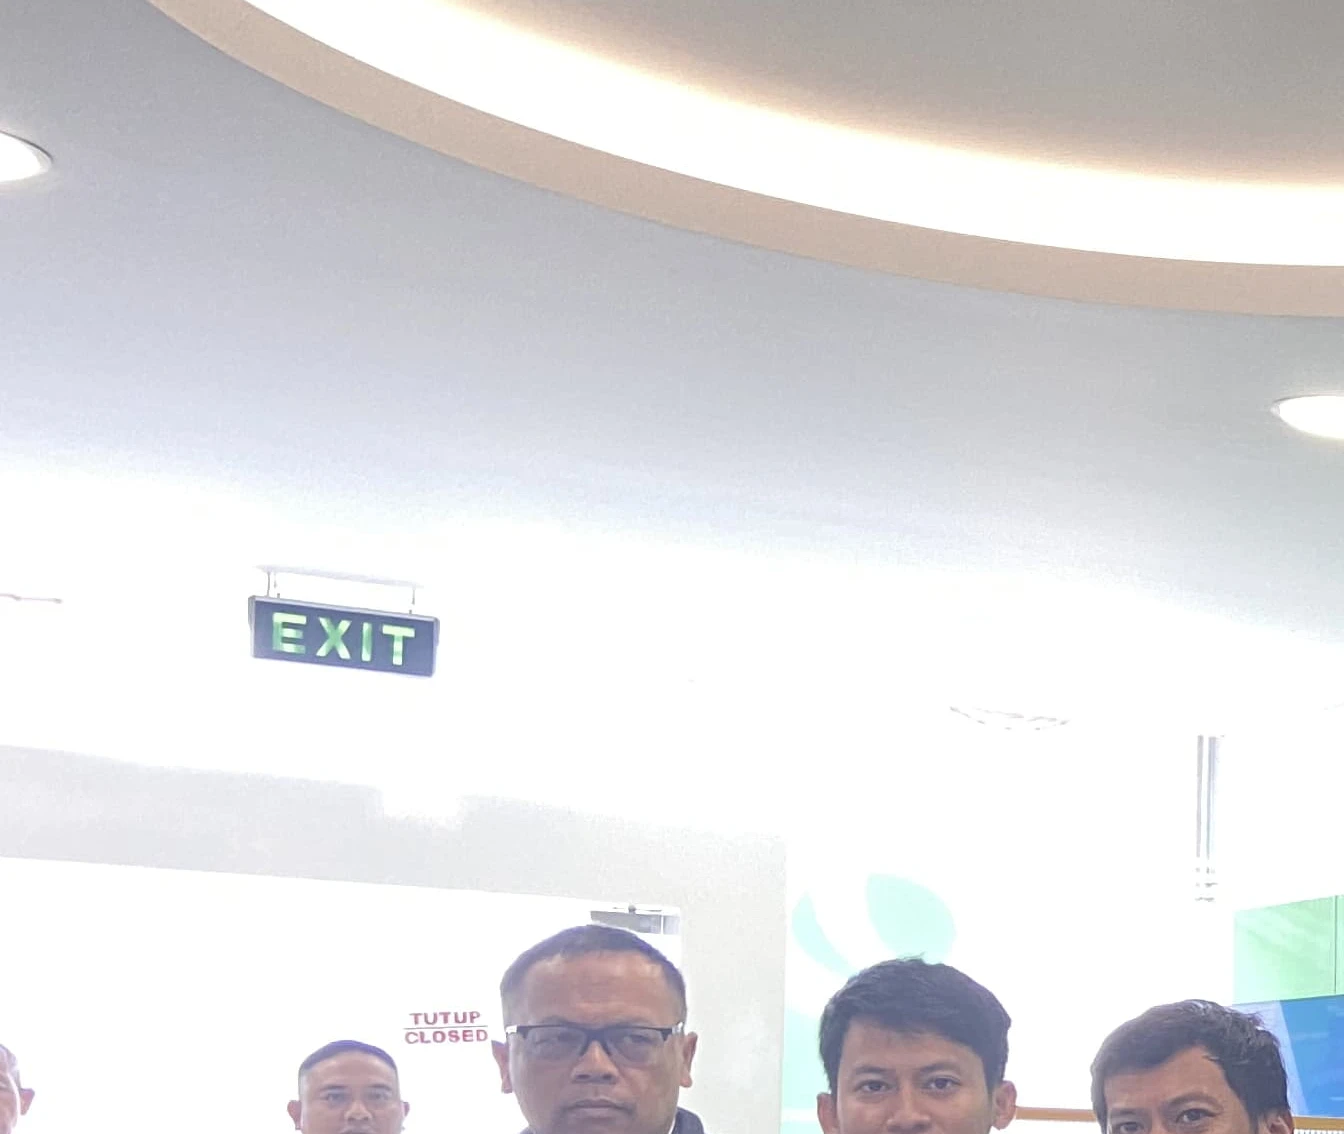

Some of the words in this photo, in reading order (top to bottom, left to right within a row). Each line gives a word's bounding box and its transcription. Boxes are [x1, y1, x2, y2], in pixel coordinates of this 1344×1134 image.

[272, 612, 415, 665] EXIT
[408, 1011, 481, 1025] TUTUP
[404, 1029, 488, 1044] CLOSED
